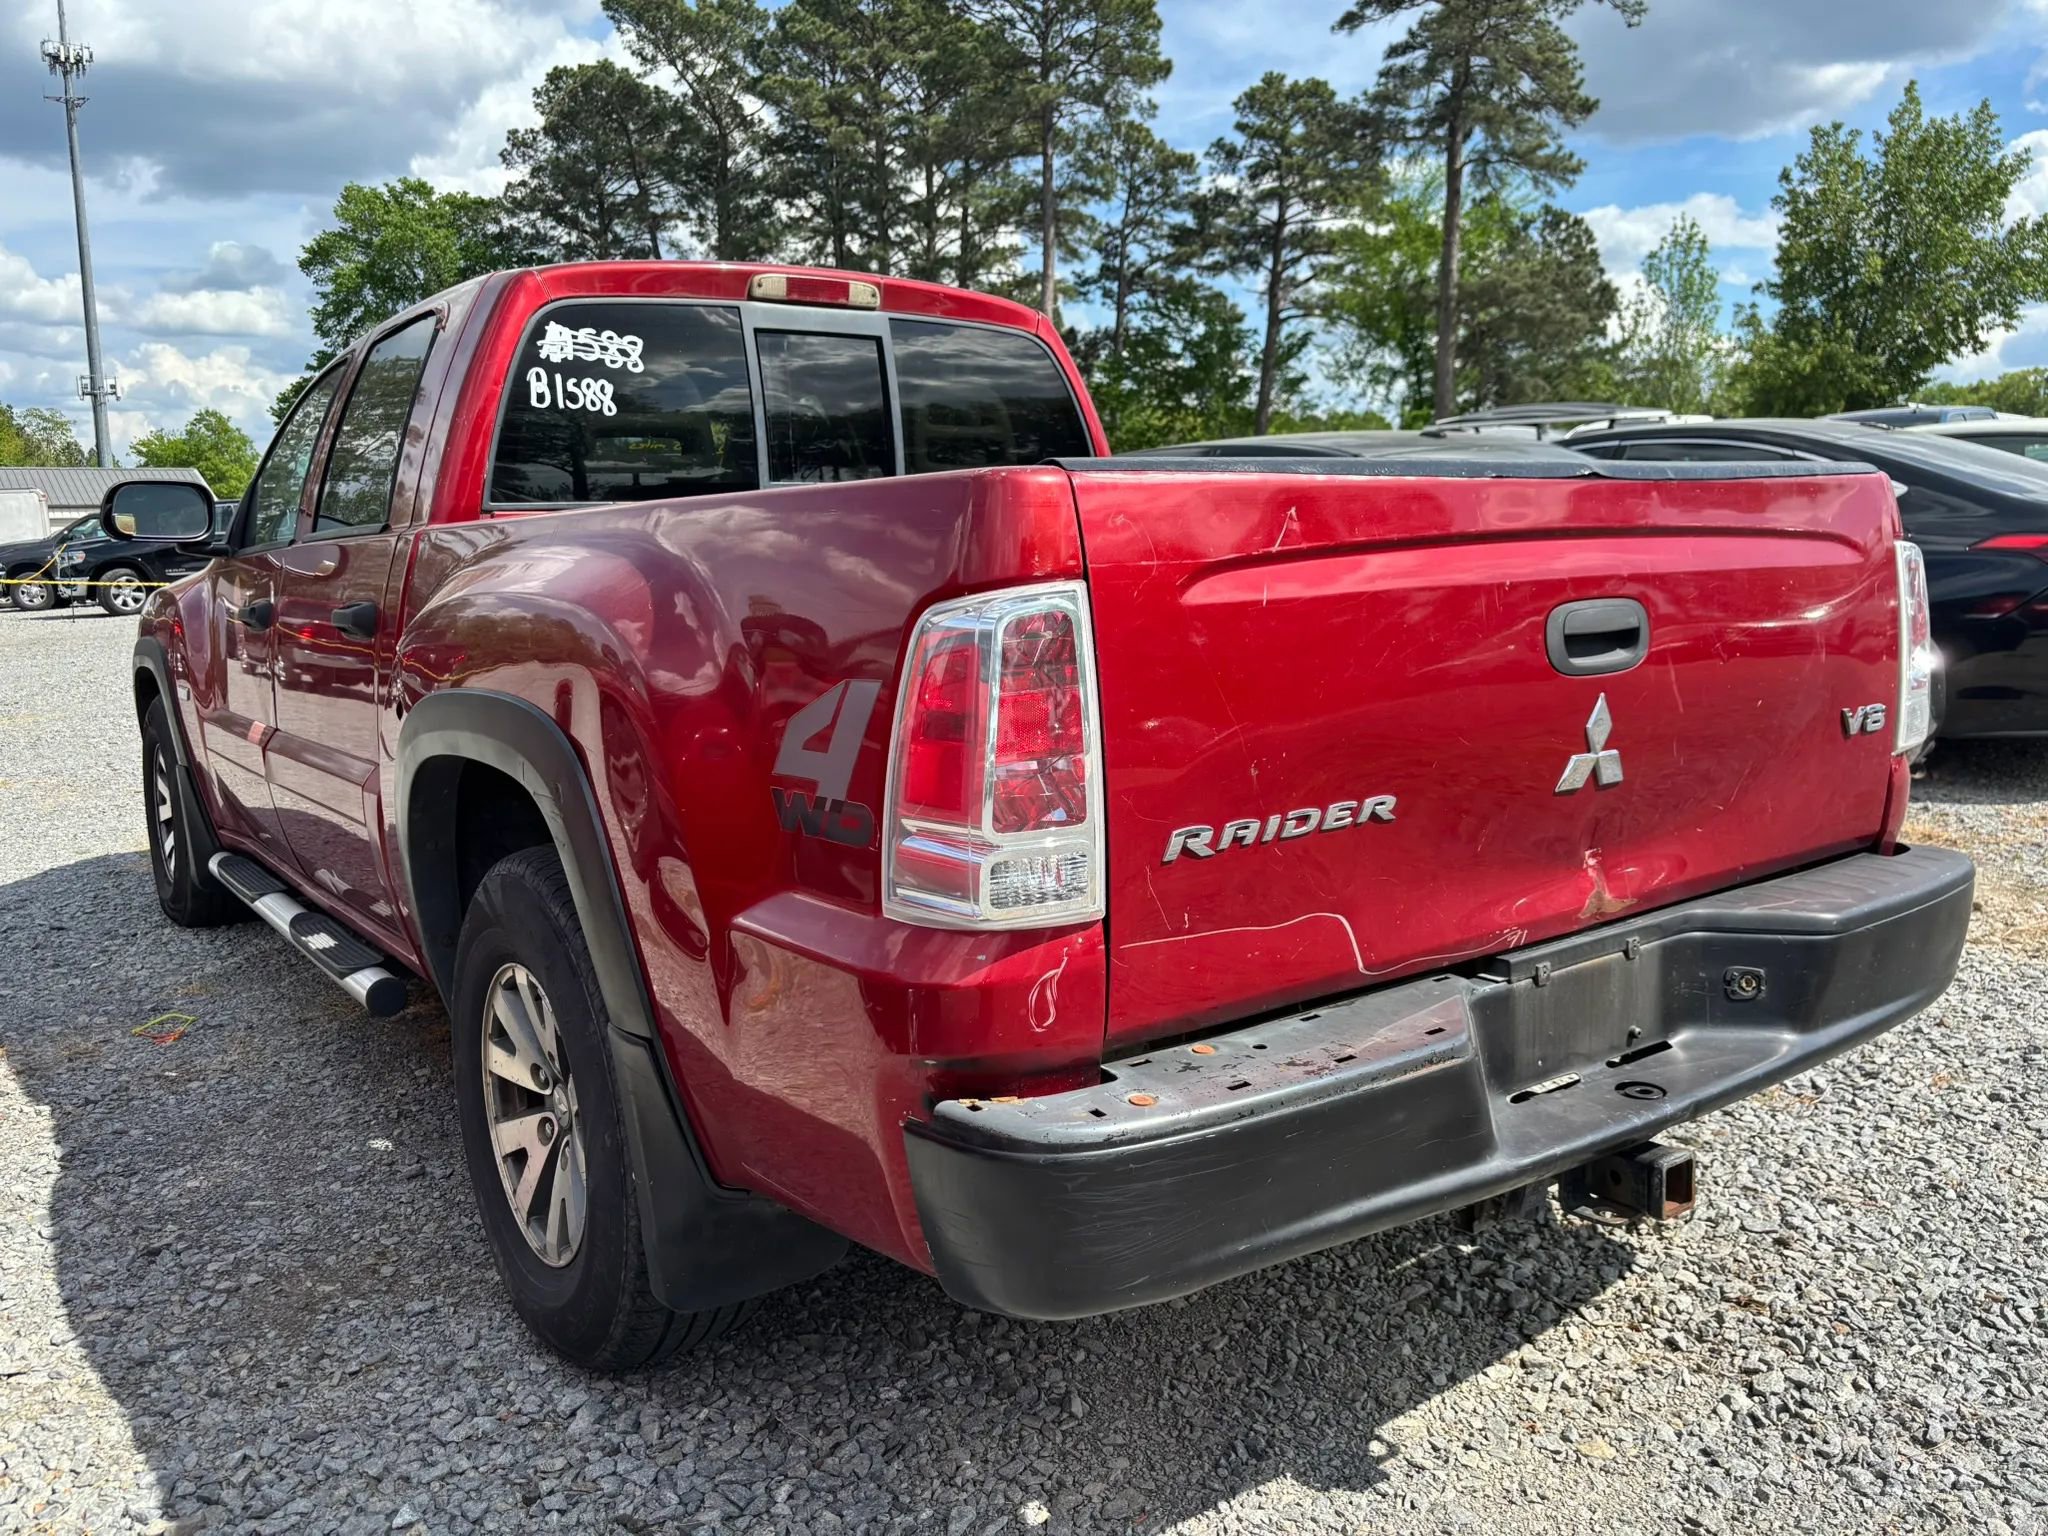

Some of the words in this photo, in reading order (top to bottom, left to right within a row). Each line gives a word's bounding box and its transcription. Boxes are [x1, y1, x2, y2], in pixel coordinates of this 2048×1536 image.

[527, 366, 618, 417] B1588
[772, 679, 883, 806] 4
[1841, 703, 1887, 738] V6
[770, 786, 876, 849] WD
[1161, 794, 1398, 864] RAIDER
